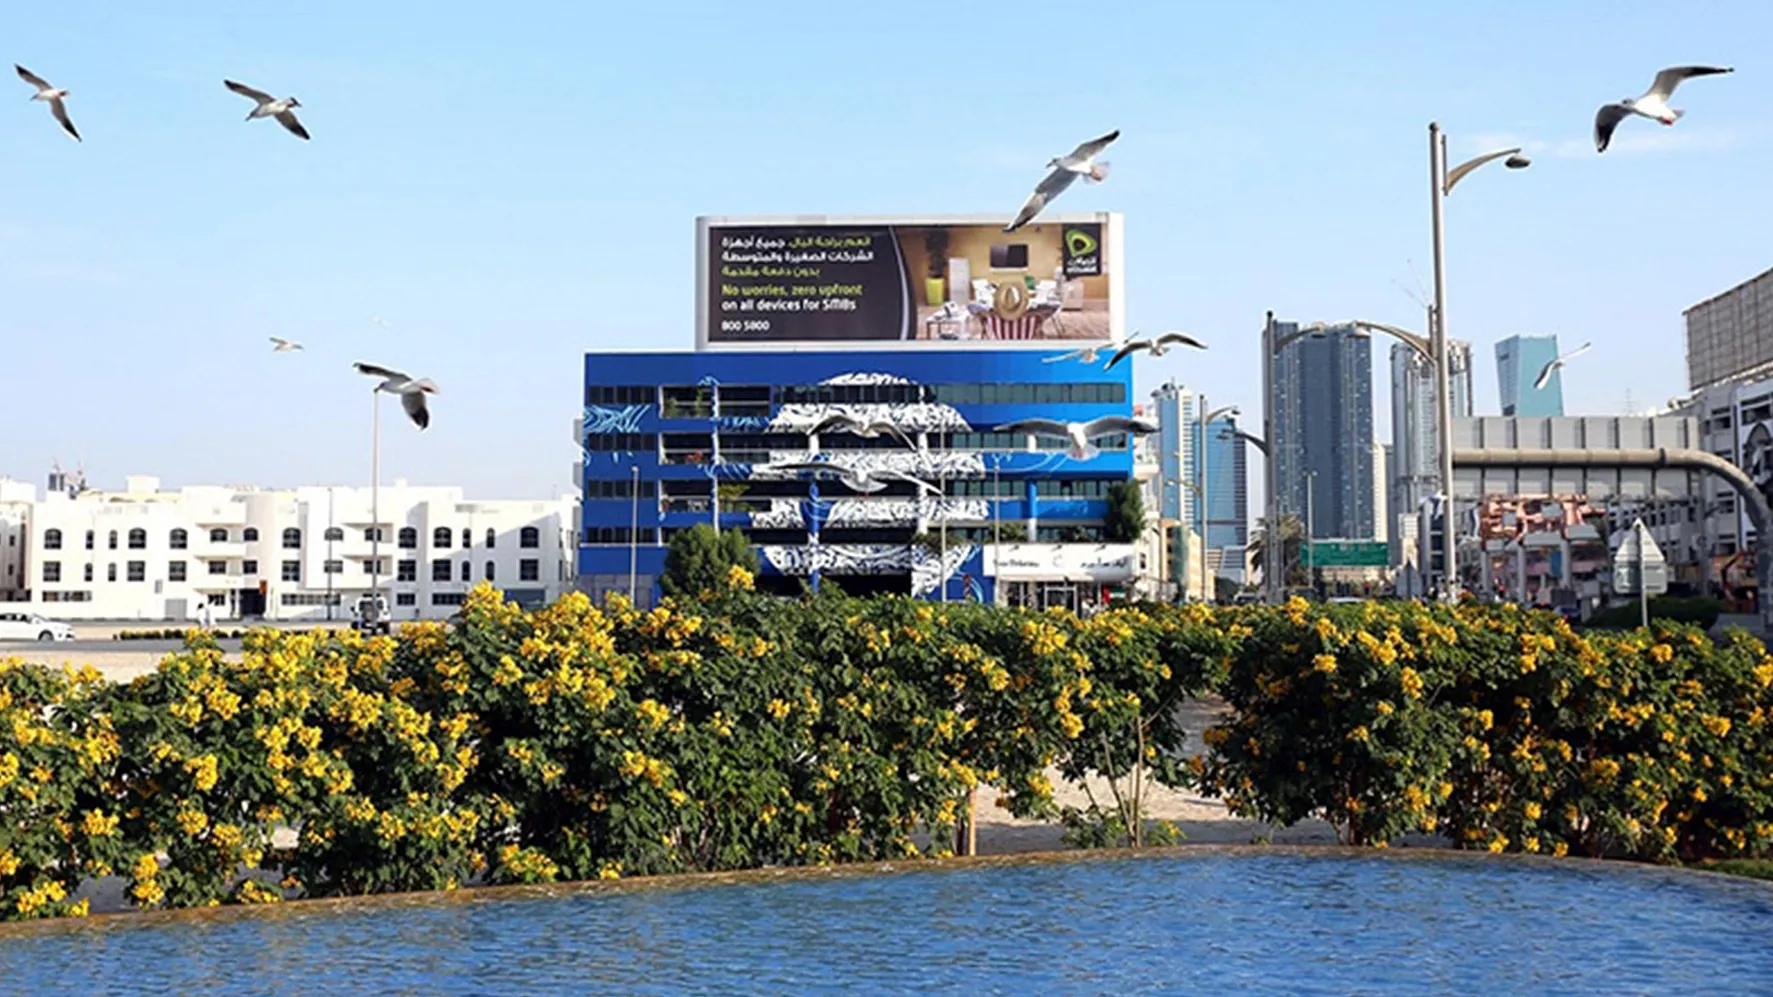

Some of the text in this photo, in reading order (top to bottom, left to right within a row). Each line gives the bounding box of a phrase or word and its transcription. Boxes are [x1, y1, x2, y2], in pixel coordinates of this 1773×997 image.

[756, 236, 786, 249] جميع
[785, 251, 826, 262] الصغيرة
[828, 249, 874, 262] الشركات
[721, 284, 863, 298] No worries, zero upfront
[721, 300, 738, 311] on
[740, 299, 754, 311] all
[756, 299, 800, 311] devices
[803, 299, 820, 311] for
[721, 320, 742, 331] 800
